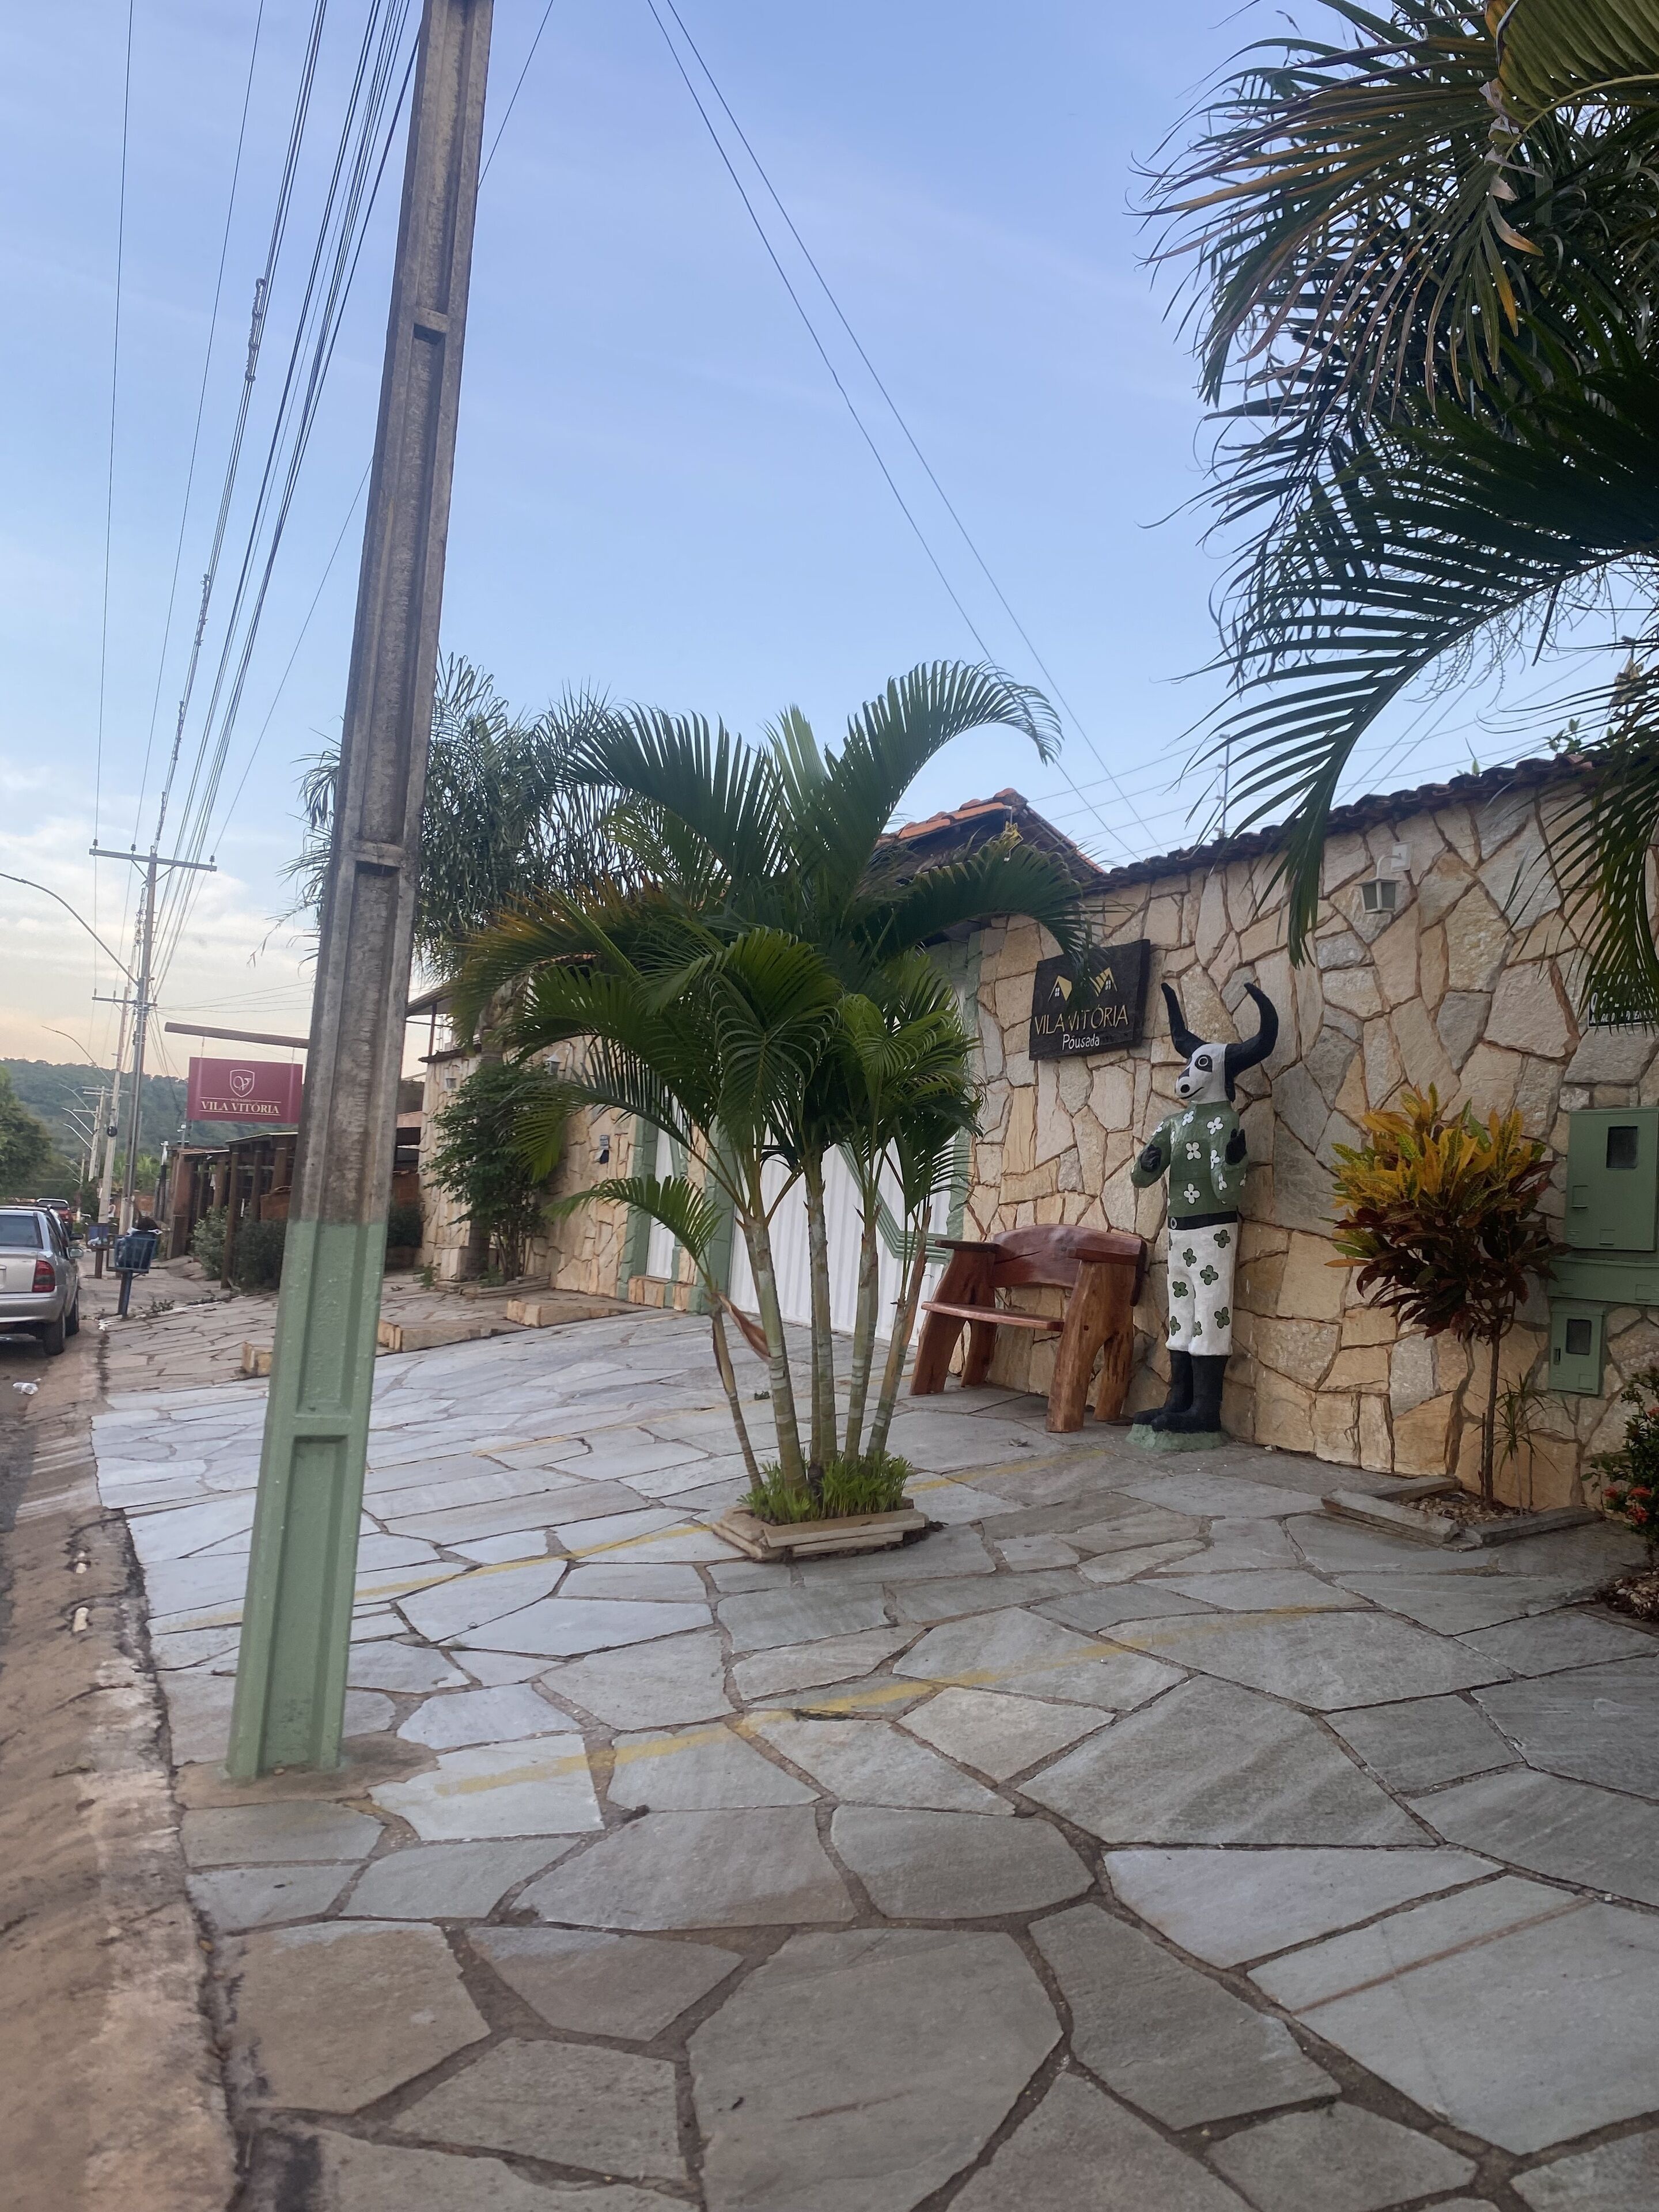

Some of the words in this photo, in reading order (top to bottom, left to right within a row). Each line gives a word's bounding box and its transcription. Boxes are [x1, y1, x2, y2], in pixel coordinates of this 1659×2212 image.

[1035, 1013, 1065, 1035] VILA
[1062, 1033, 1100, 1051] Pousada
[201, 1101, 229, 1111] VILA
[232, 1102, 280, 1114] VITÓRIA
